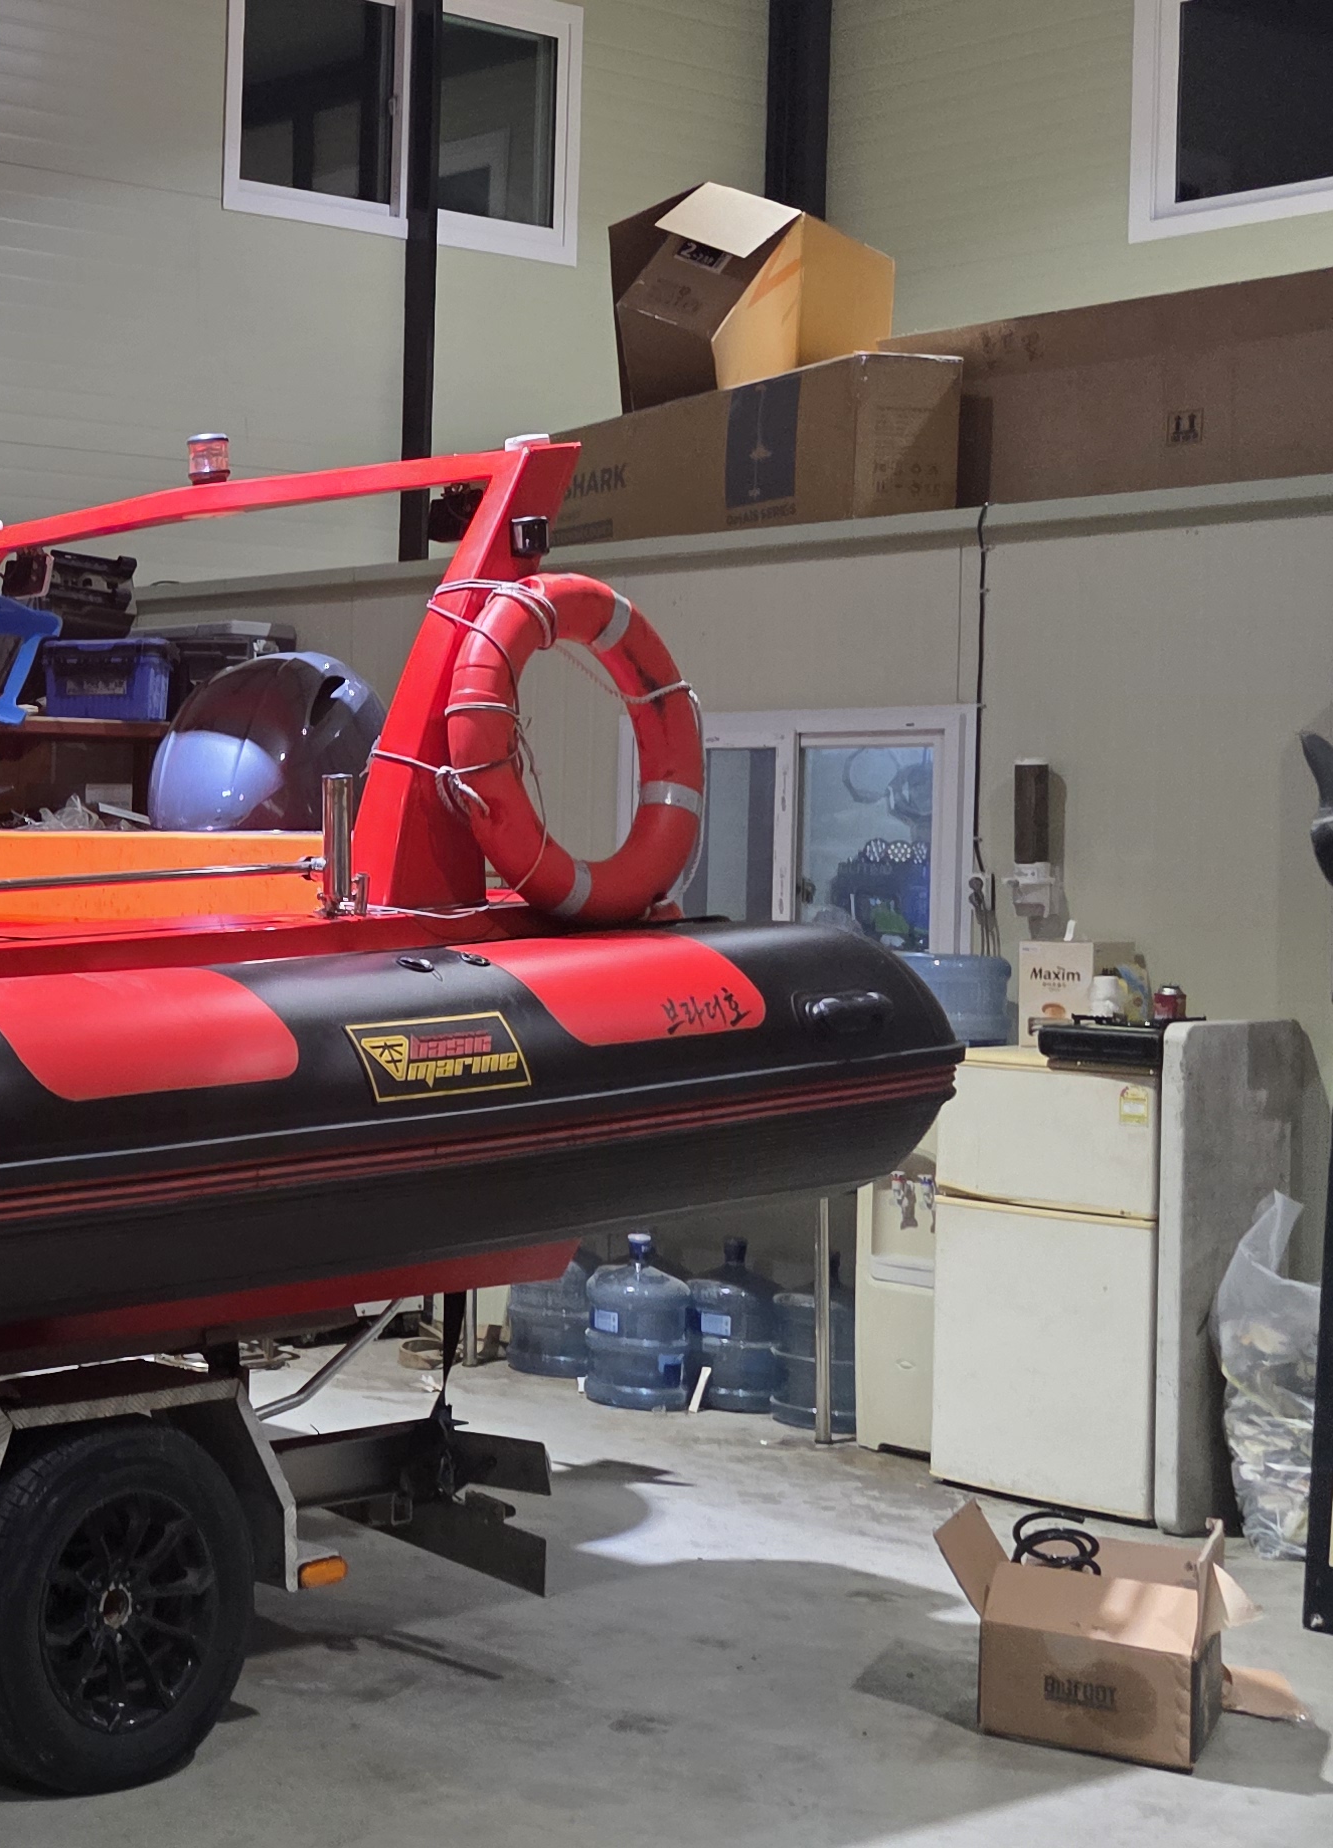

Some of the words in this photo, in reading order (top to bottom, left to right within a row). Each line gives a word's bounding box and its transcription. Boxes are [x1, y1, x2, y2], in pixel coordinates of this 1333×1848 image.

[1030, 966, 1081, 982] Maxim
[410, 1031, 492, 1060] basic
[407, 1052, 519, 1088] marine
